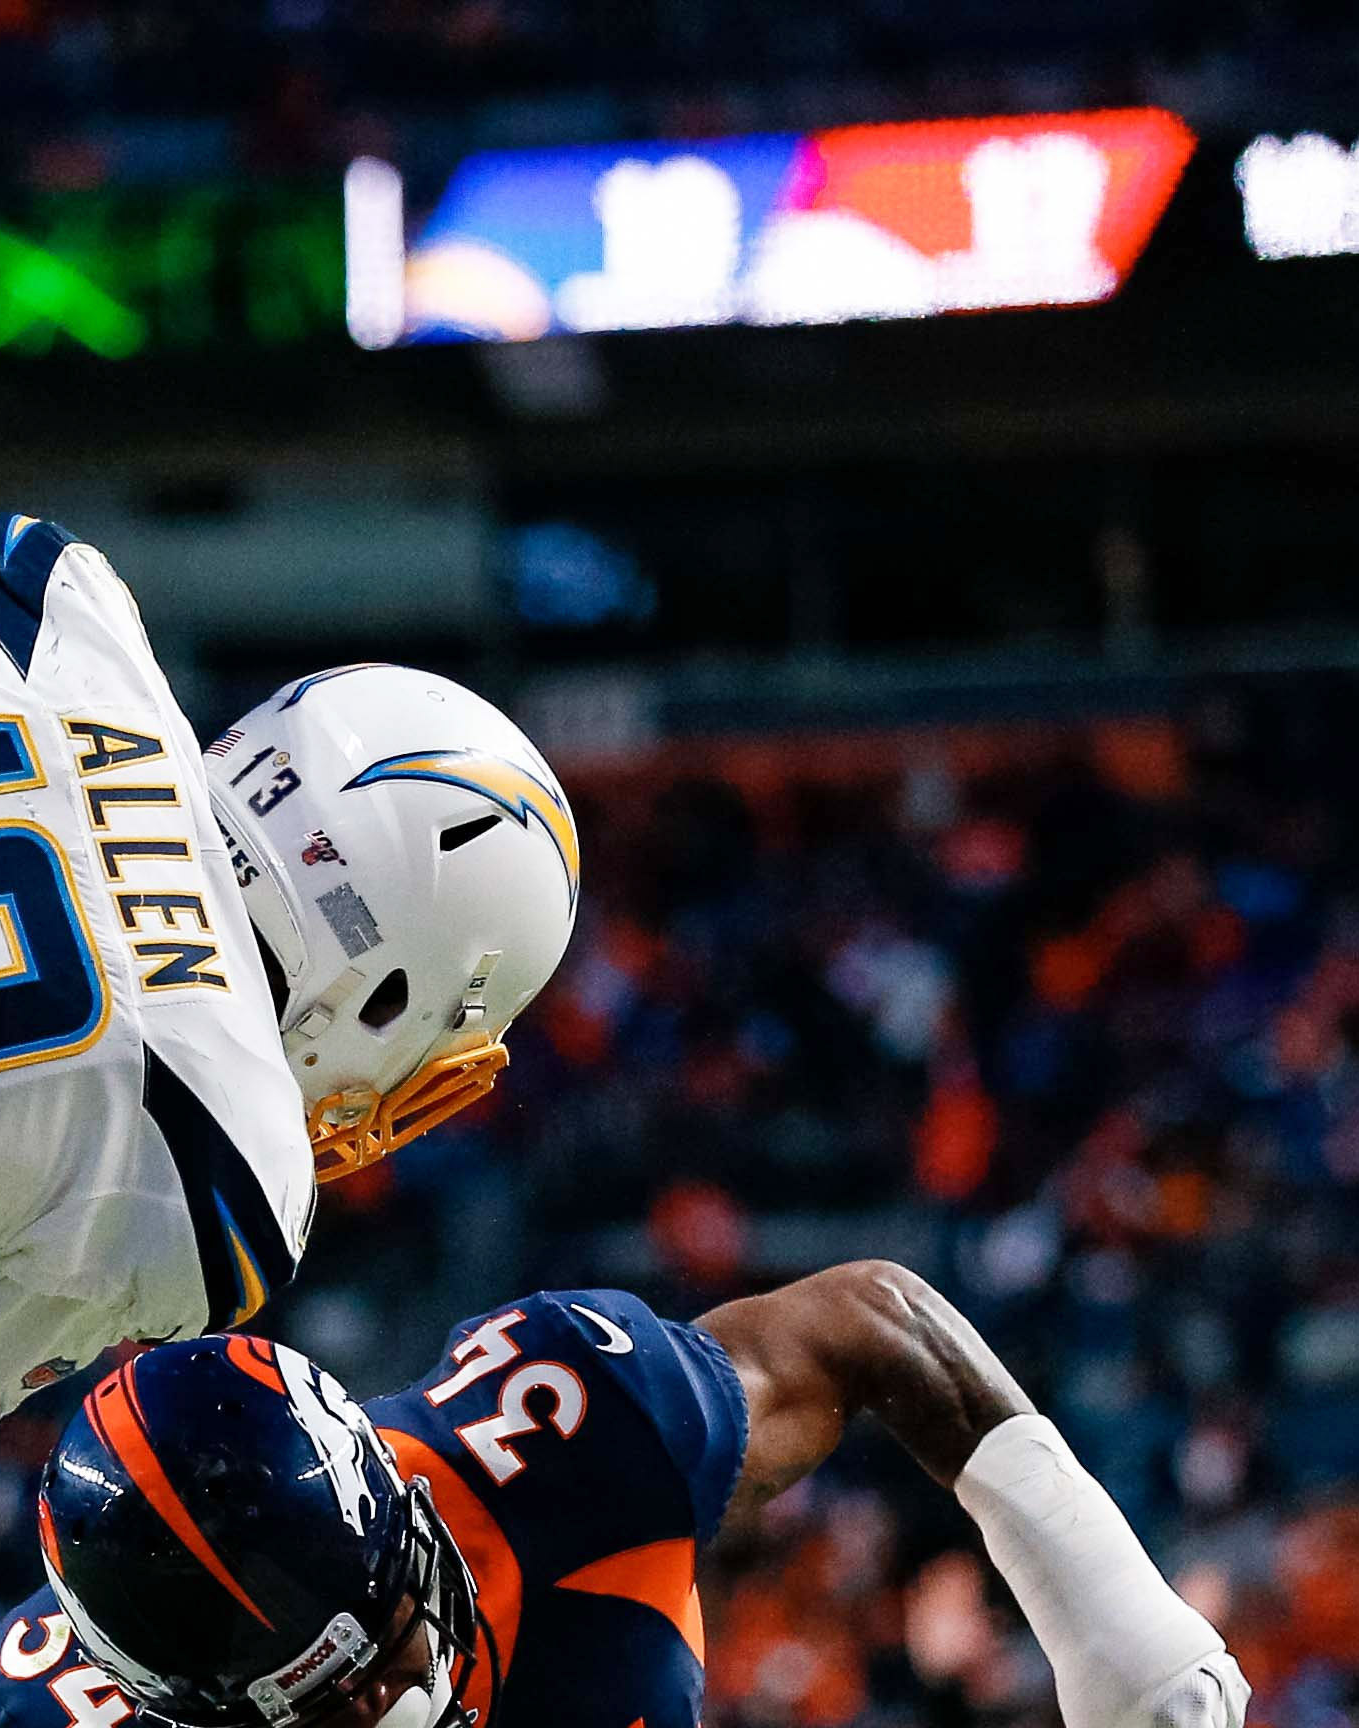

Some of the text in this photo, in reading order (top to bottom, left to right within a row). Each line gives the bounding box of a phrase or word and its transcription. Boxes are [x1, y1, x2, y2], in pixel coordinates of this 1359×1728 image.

[59, 717, 231, 994] ALLEN
[229, 745, 302, 818] 13
[424, 1309, 588, 1487] 34
